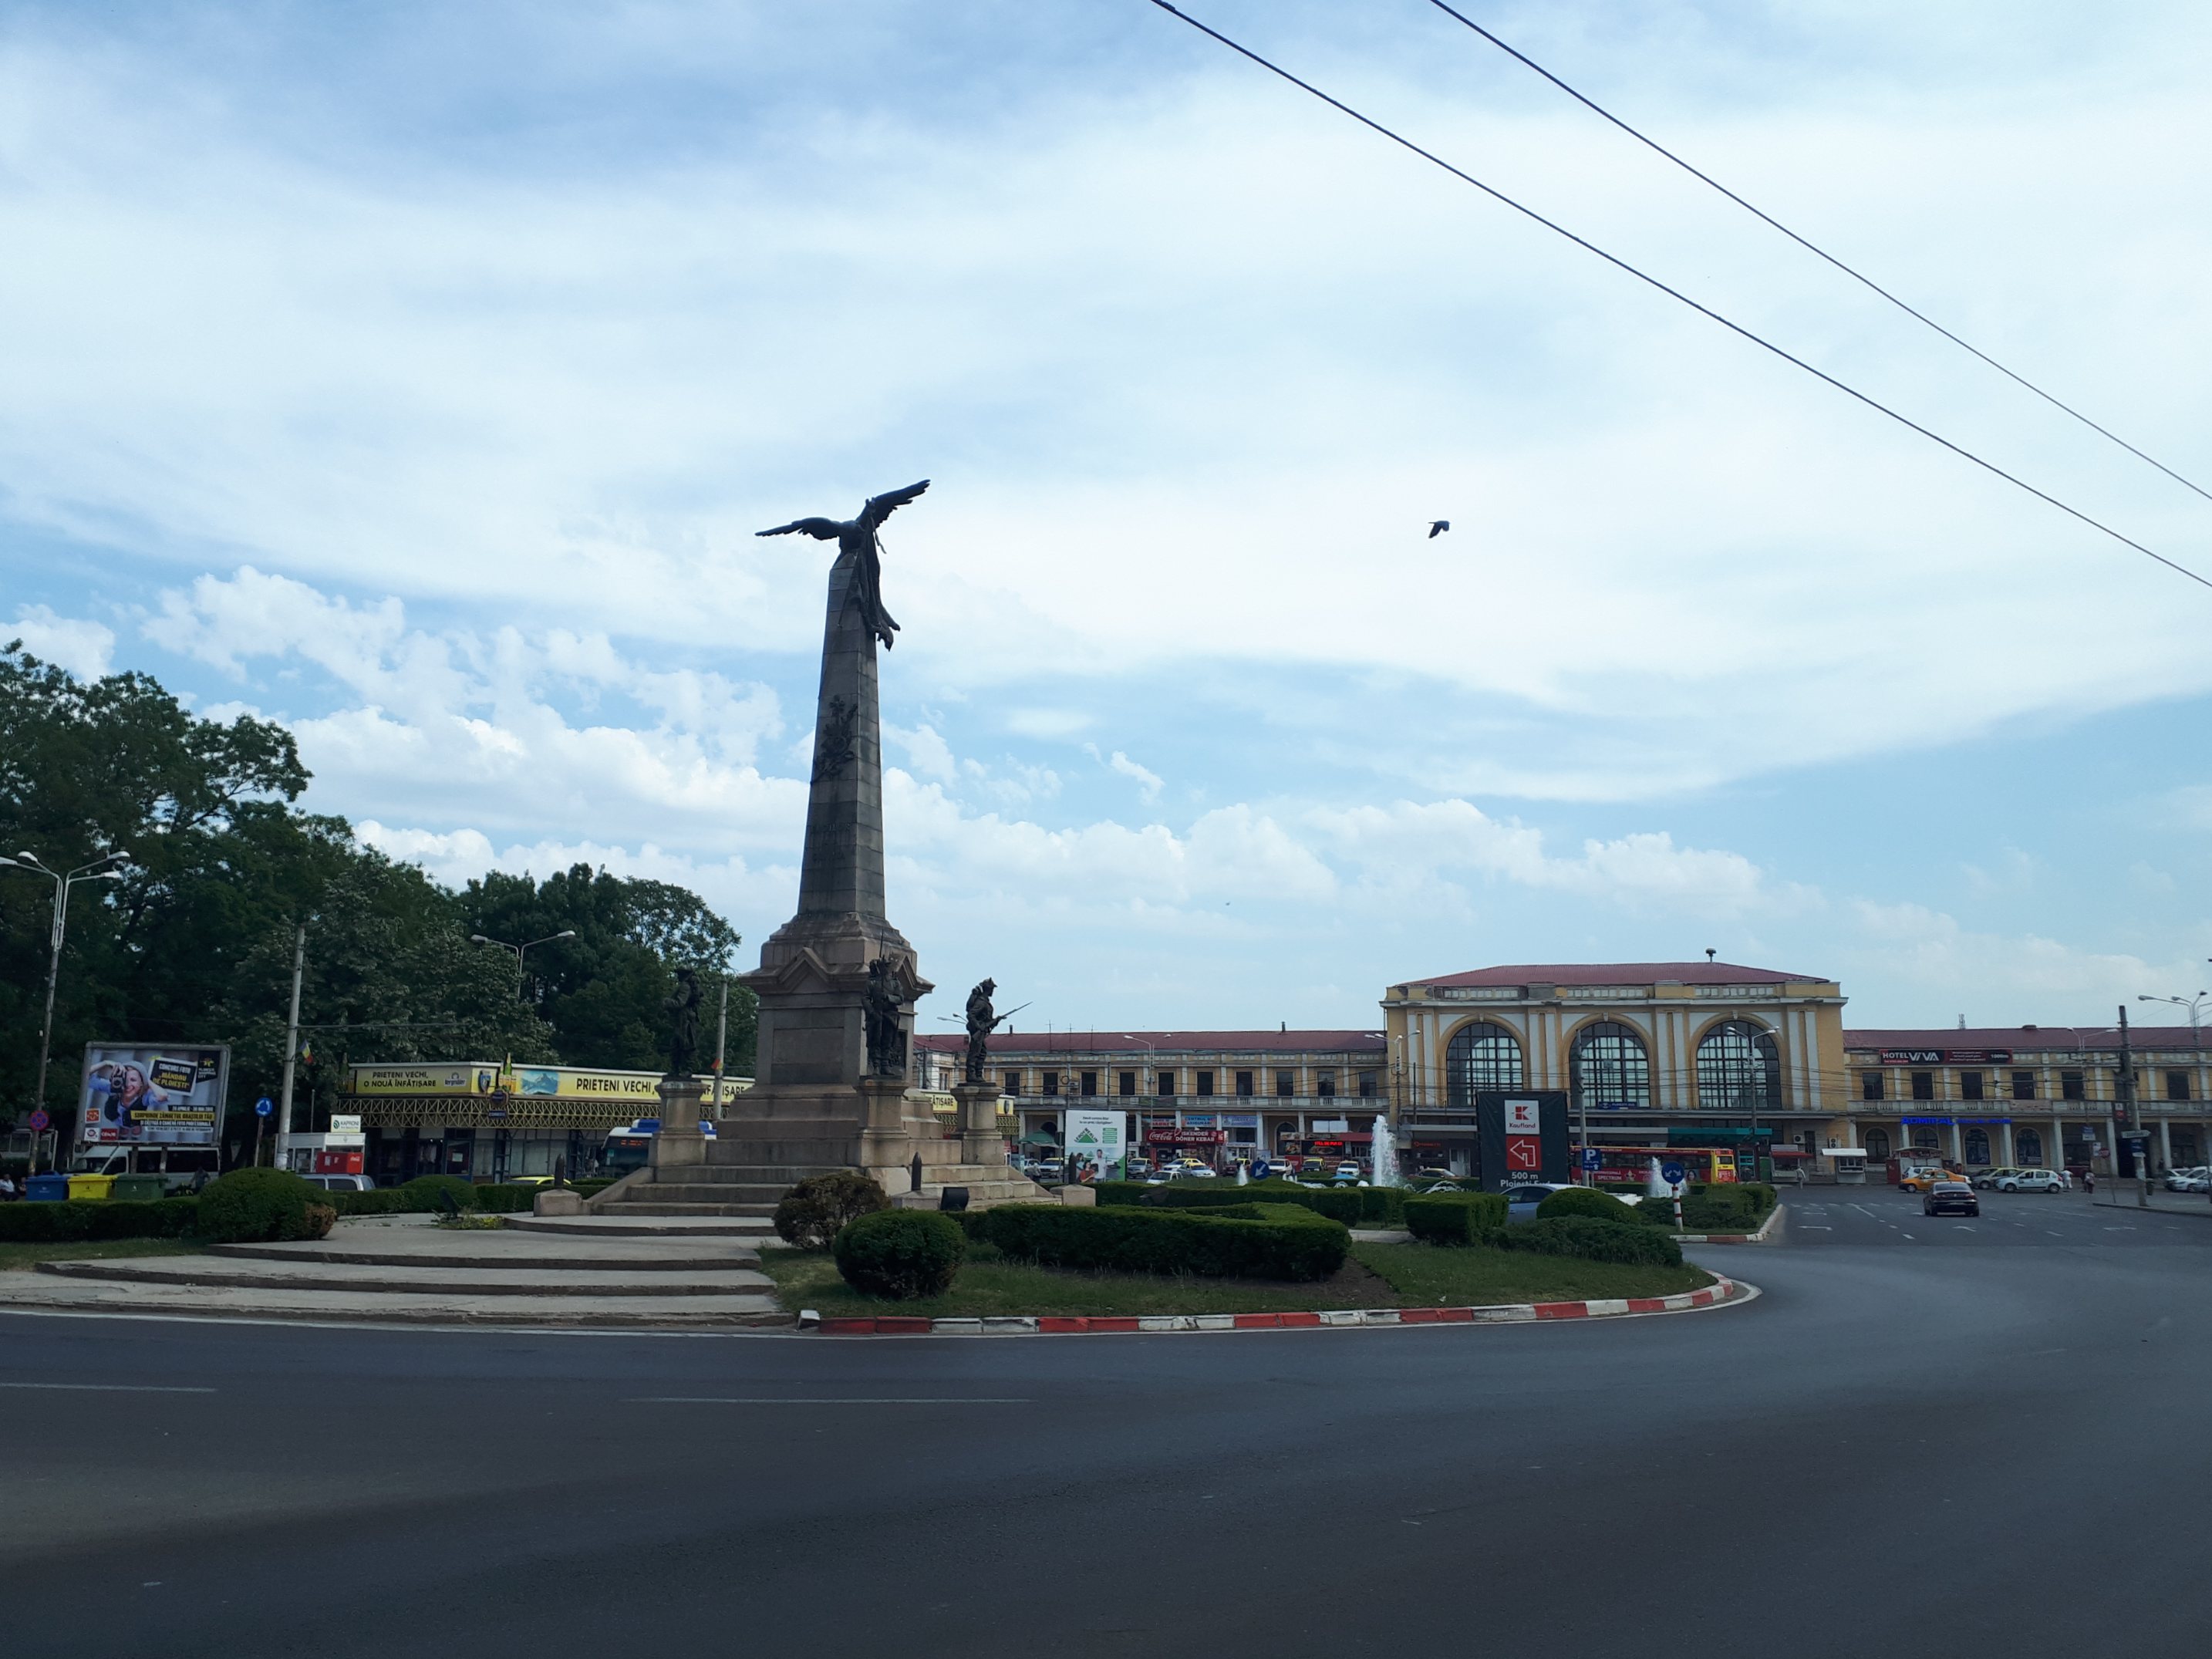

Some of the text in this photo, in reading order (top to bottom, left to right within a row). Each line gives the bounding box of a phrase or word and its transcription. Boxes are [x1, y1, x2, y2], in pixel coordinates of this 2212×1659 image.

[371, 1078, 393, 1087] NOUĂ
[576, 1077, 655, 1095] PRIETENI VECHI,
[1900, 1116, 1955, 1125] ADMIRAL
[1074, 1131, 1086, 1142] LEROY
[1084, 1128, 1098, 1143] MERLIN
[1586, 1148, 1597, 1161] P
